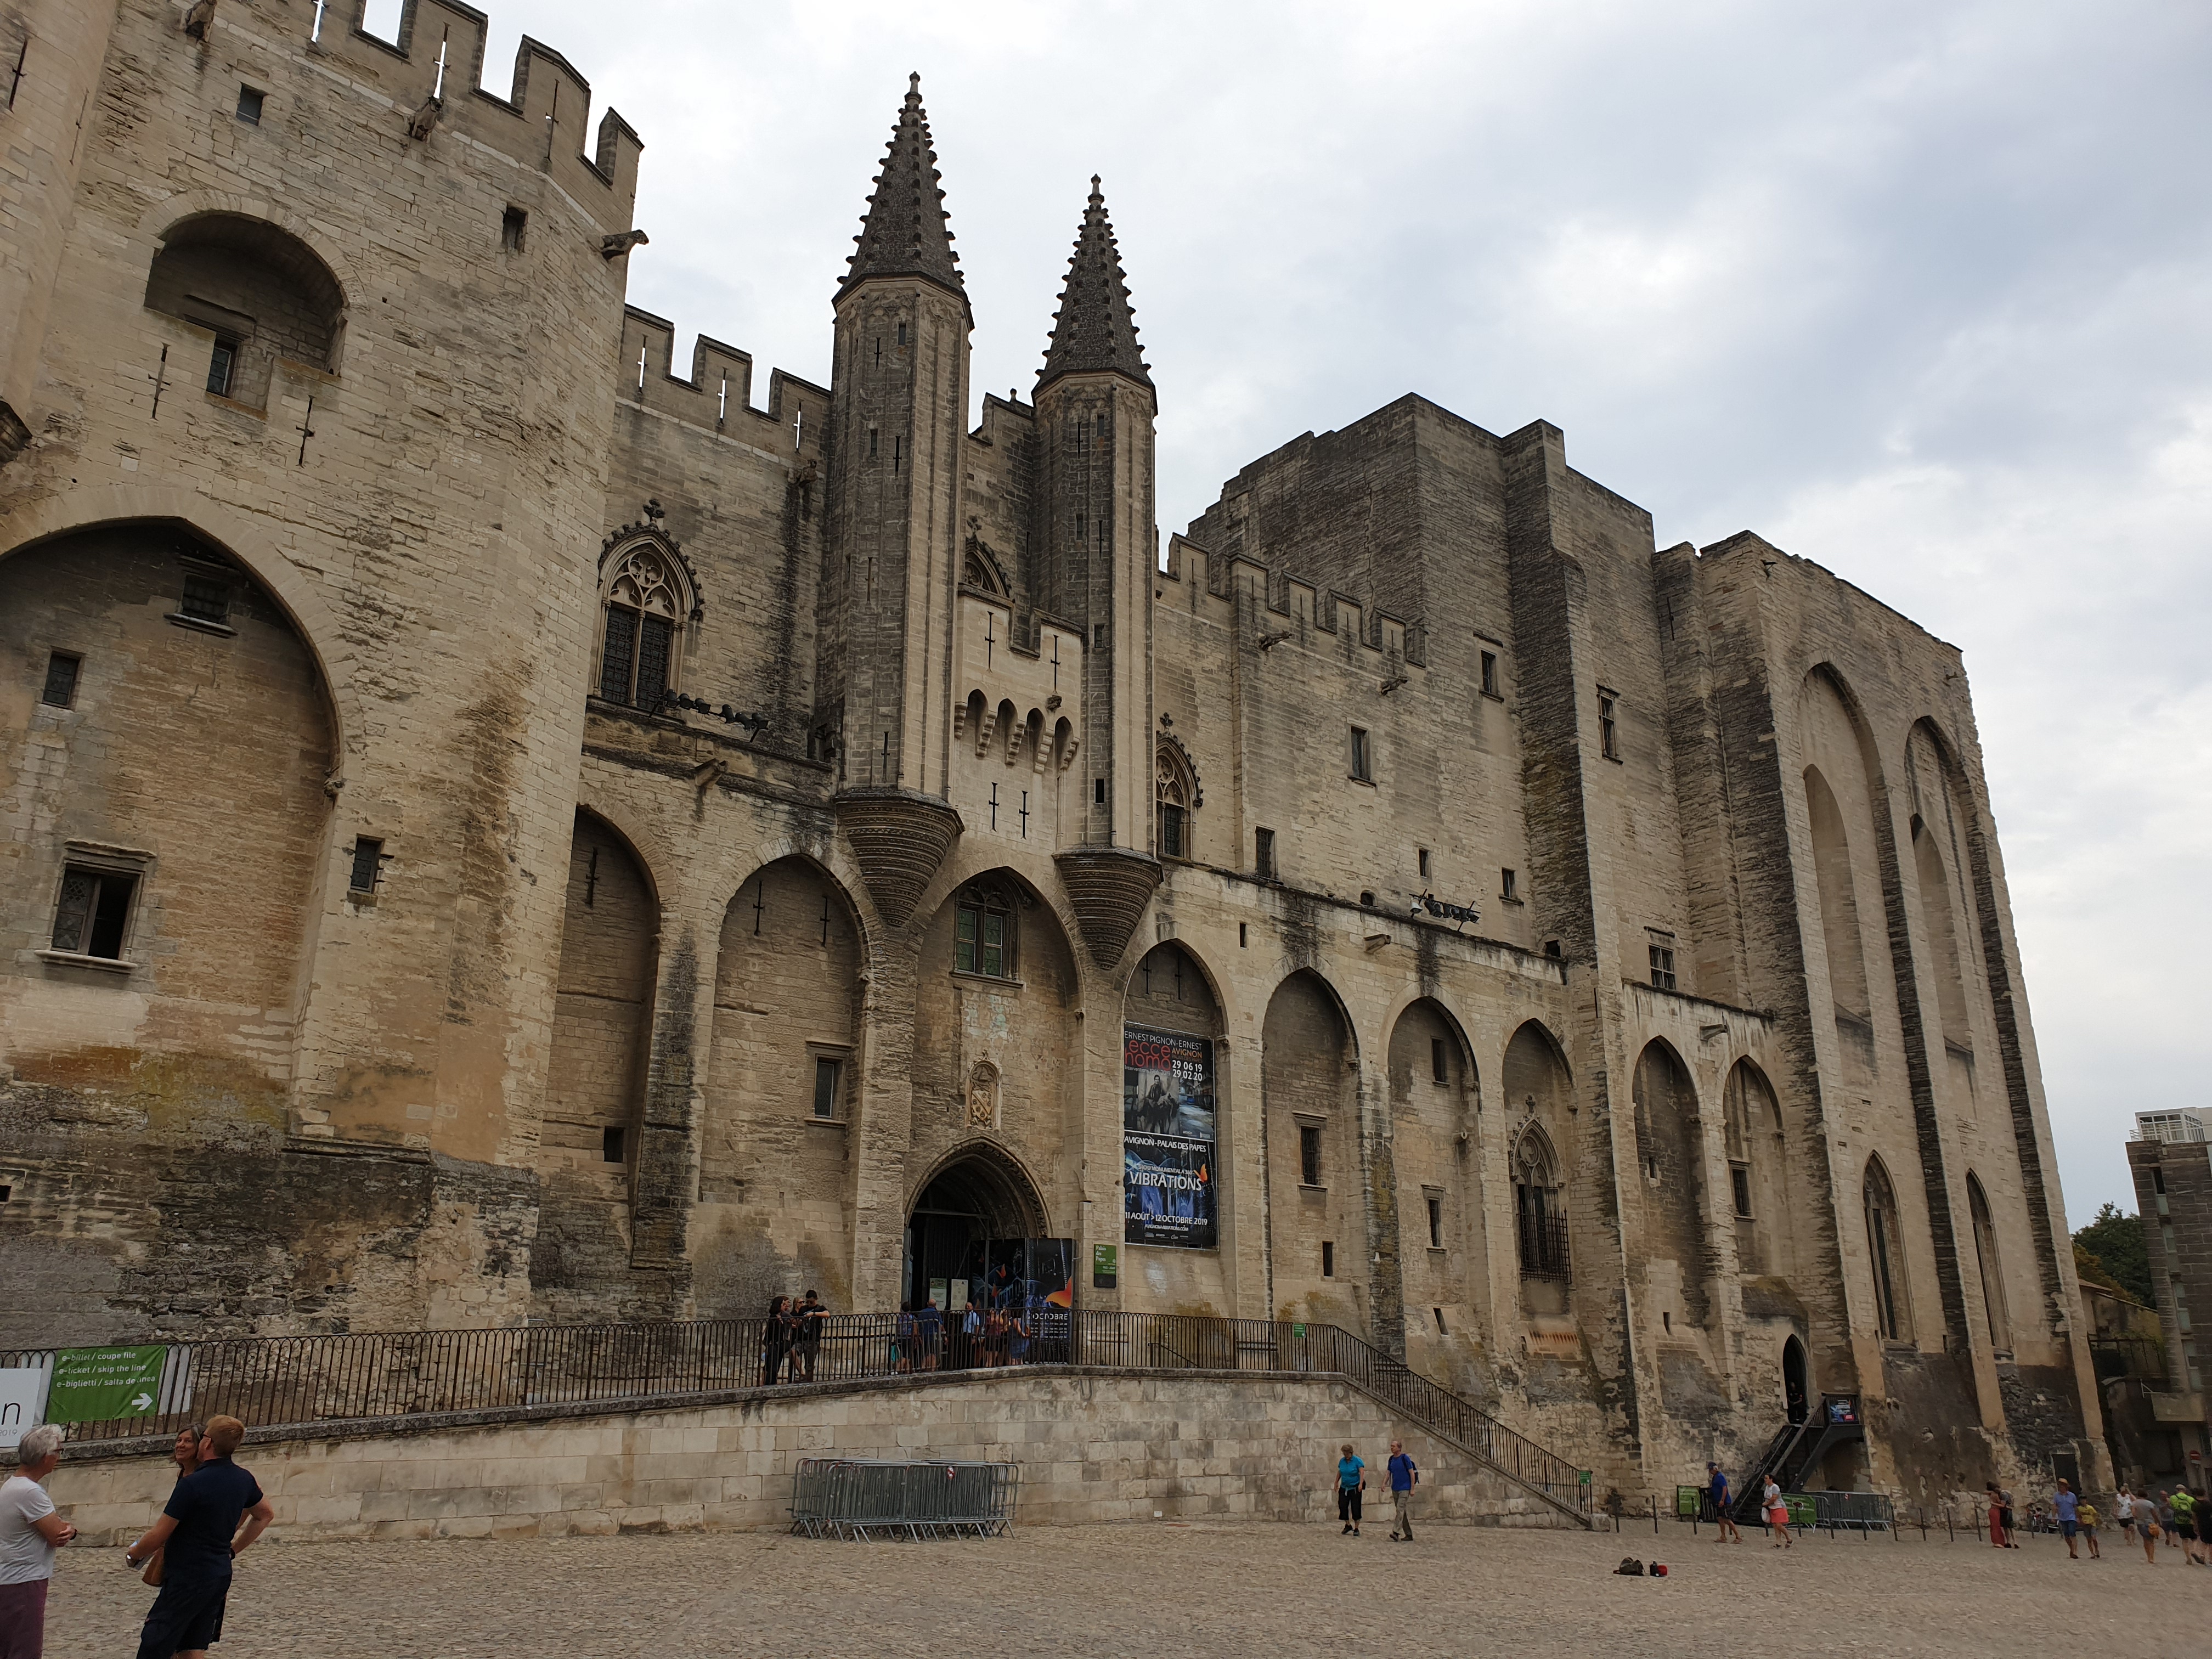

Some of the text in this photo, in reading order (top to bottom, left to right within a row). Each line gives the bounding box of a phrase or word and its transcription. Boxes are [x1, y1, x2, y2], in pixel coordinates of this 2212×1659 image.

[1124, 1031, 1202, 1050] ERNEST PIGNON-ERNEST
[1129, 1040, 1171, 1058] ecce
[1171, 1047, 1202, 1058] AVIGNON
[1125, 1047, 1171, 1071] homo
[1172, 1059, 1203, 1072] 29 06 19
[1172, 1069, 1203, 1081] 29 02 20
[1124, 1136, 1154, 1146] AVIGNON
[1157, 1139, 1177, 1149] PALAIS
[1177, 1142, 1189, 1150] DES
[1189, 1143, 1206, 1152] PAPES
[1152, 1166, 1181, 1174] MONUMENTAL
[1130, 1171, 1203, 1191] VIBRATIONS
[1130, 1211, 1150, 1221] AOÛT
[1162, 1215, 1193, 1224] OCTOBRE
[1194, 1217, 1207, 1226] 2019
[61, 1353, 90, 1361] e-billet
[59, 1366, 90, 1374] e-ticket
[98, 1365, 114, 1374] skip
[56, 1379, 97, 1389] e-biglietti
